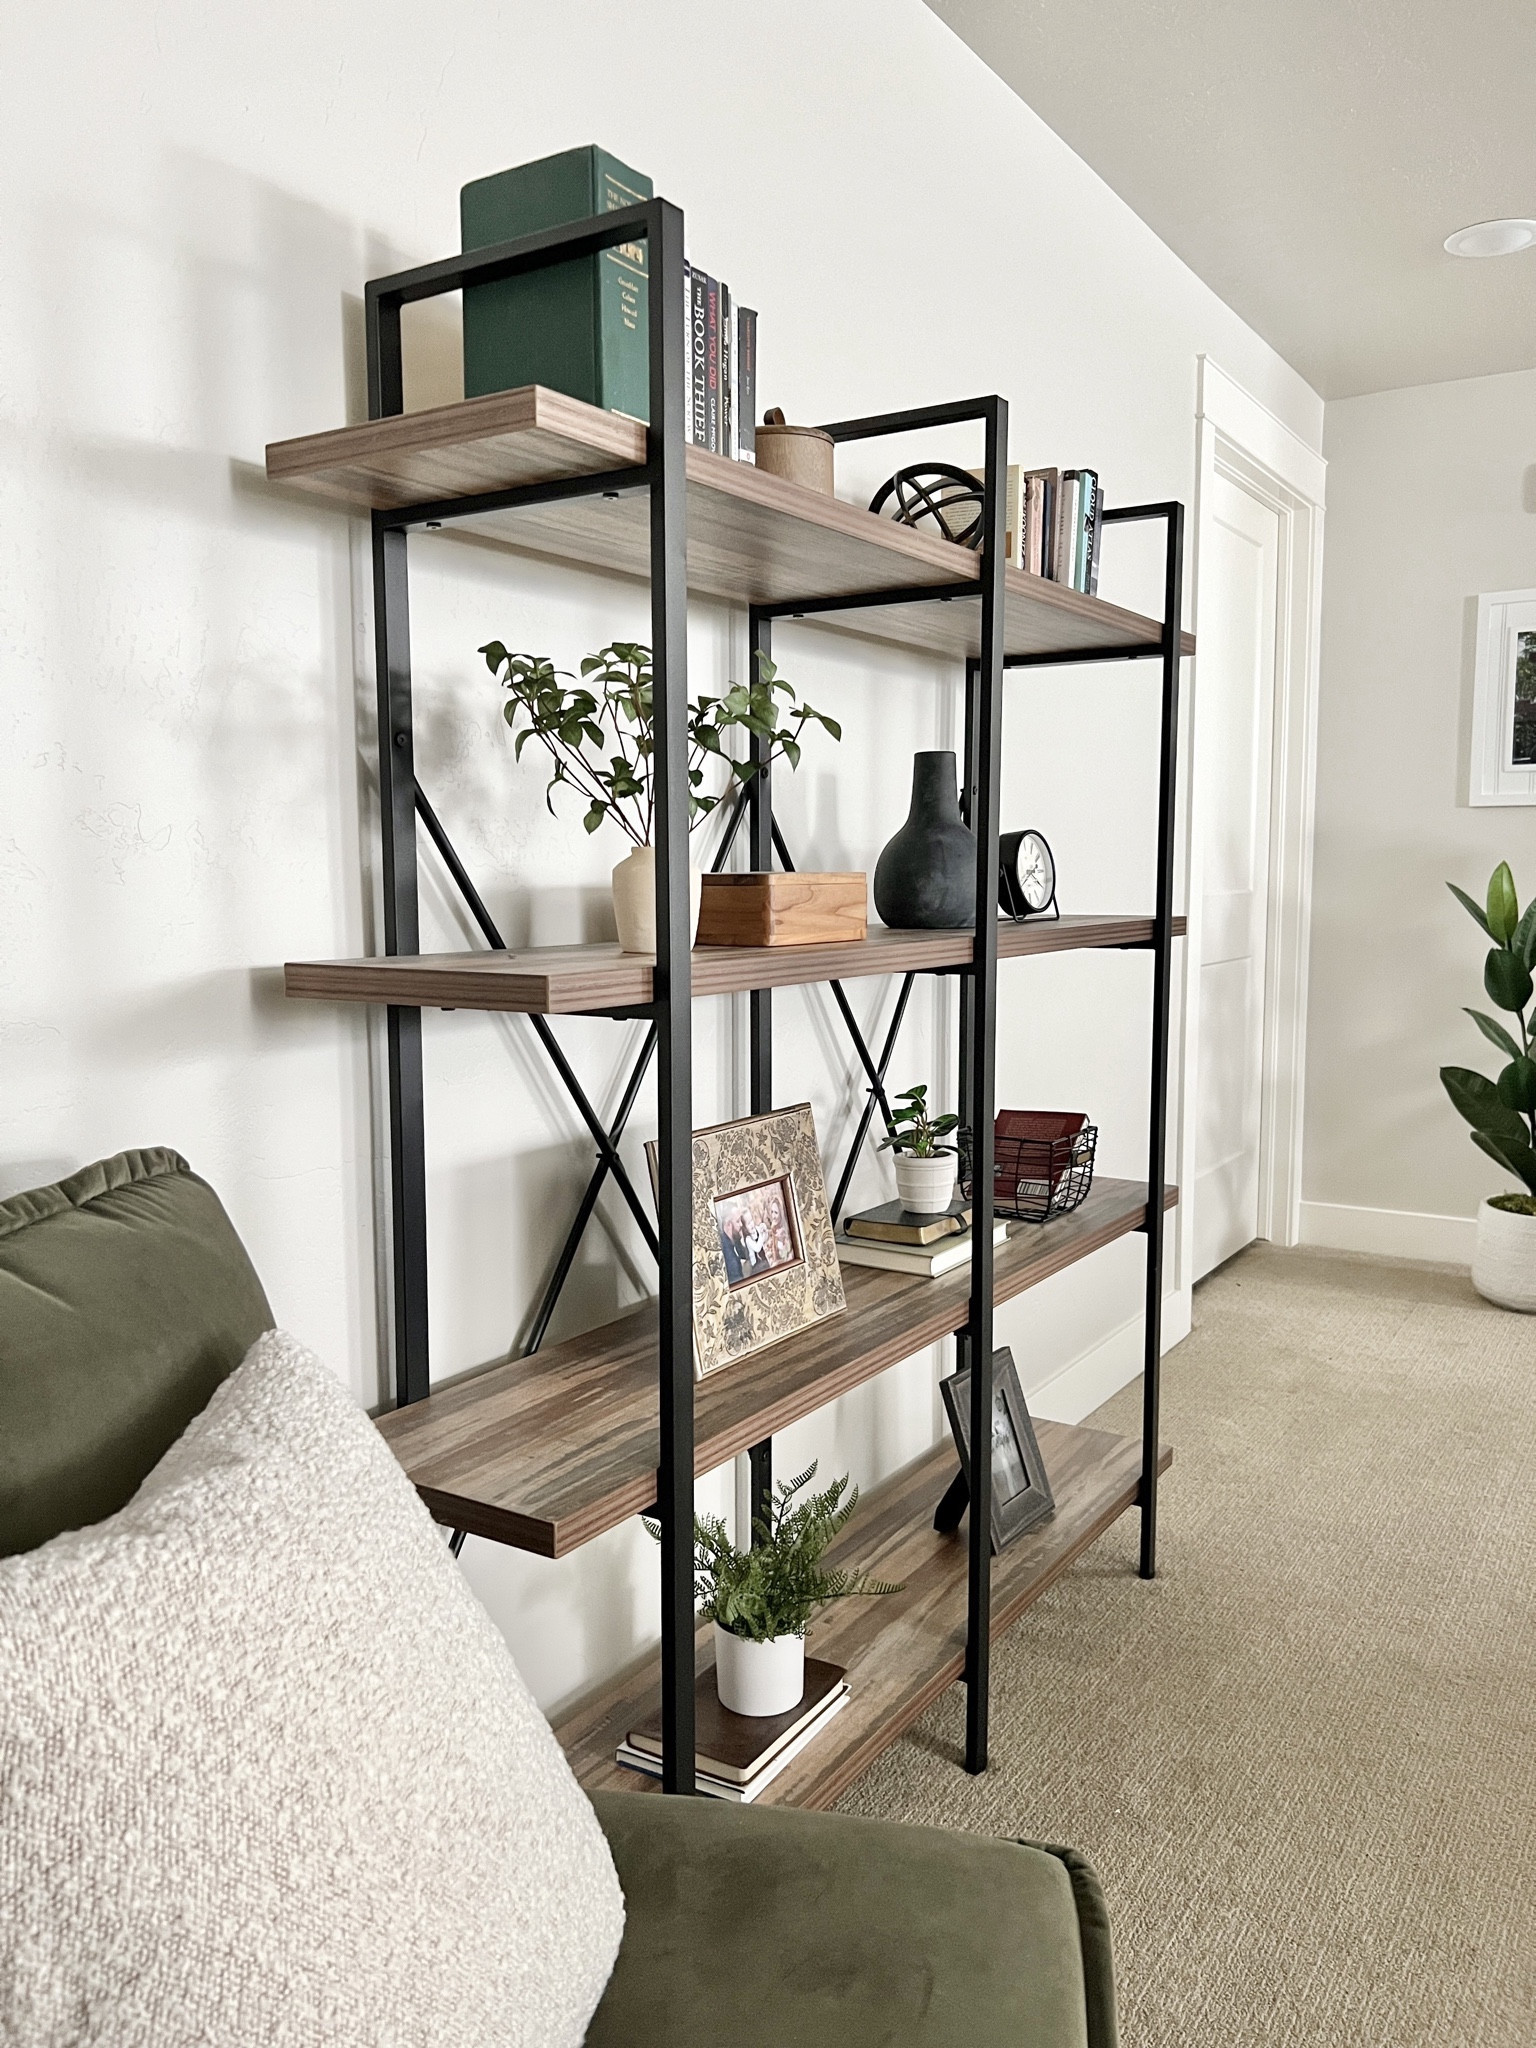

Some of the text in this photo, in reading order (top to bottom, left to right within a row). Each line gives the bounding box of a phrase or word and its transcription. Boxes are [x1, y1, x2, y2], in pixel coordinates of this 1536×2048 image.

[694, 304, 705, 370] BOOK
[708, 292, 717, 390] WHAT YOU DID
[694, 375, 706, 442] THIEF
[1089, 476, 1098, 522] CLOUD
